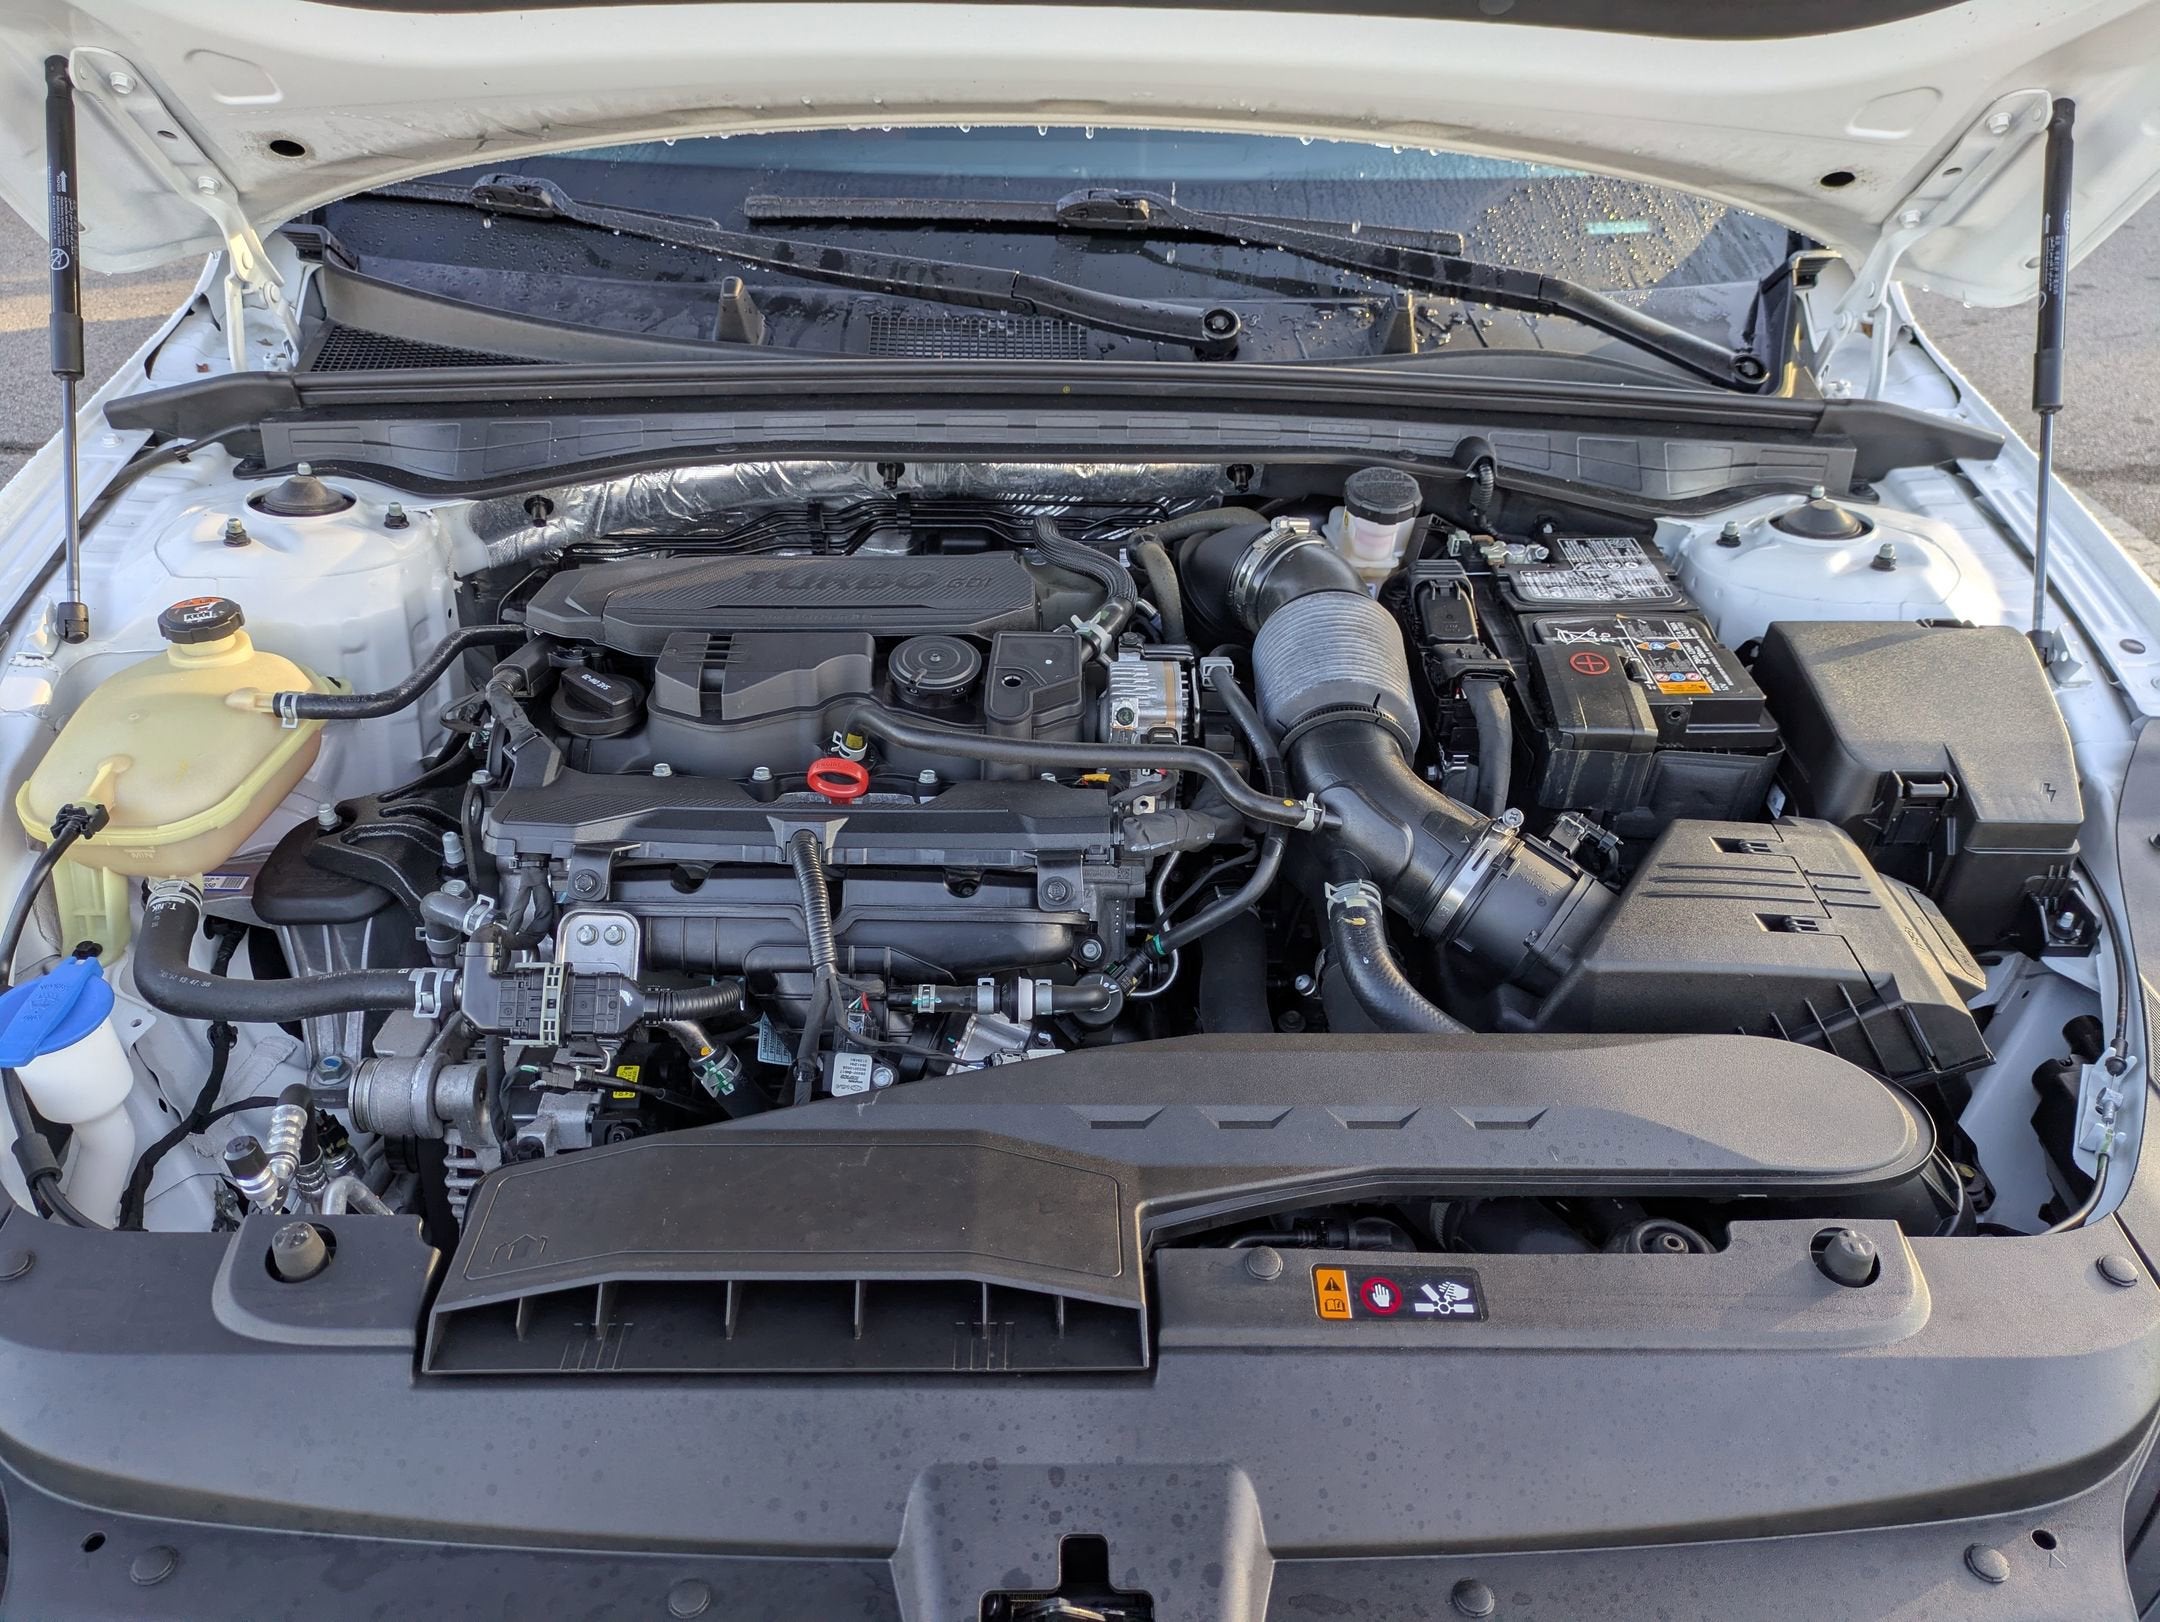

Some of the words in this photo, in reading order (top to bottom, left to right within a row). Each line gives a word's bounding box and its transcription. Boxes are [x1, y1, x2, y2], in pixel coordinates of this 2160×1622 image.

[744, 571, 940, 590] TURBO
[946, 577, 992, 589] GDI
[597, 682, 612, 691] SAE
